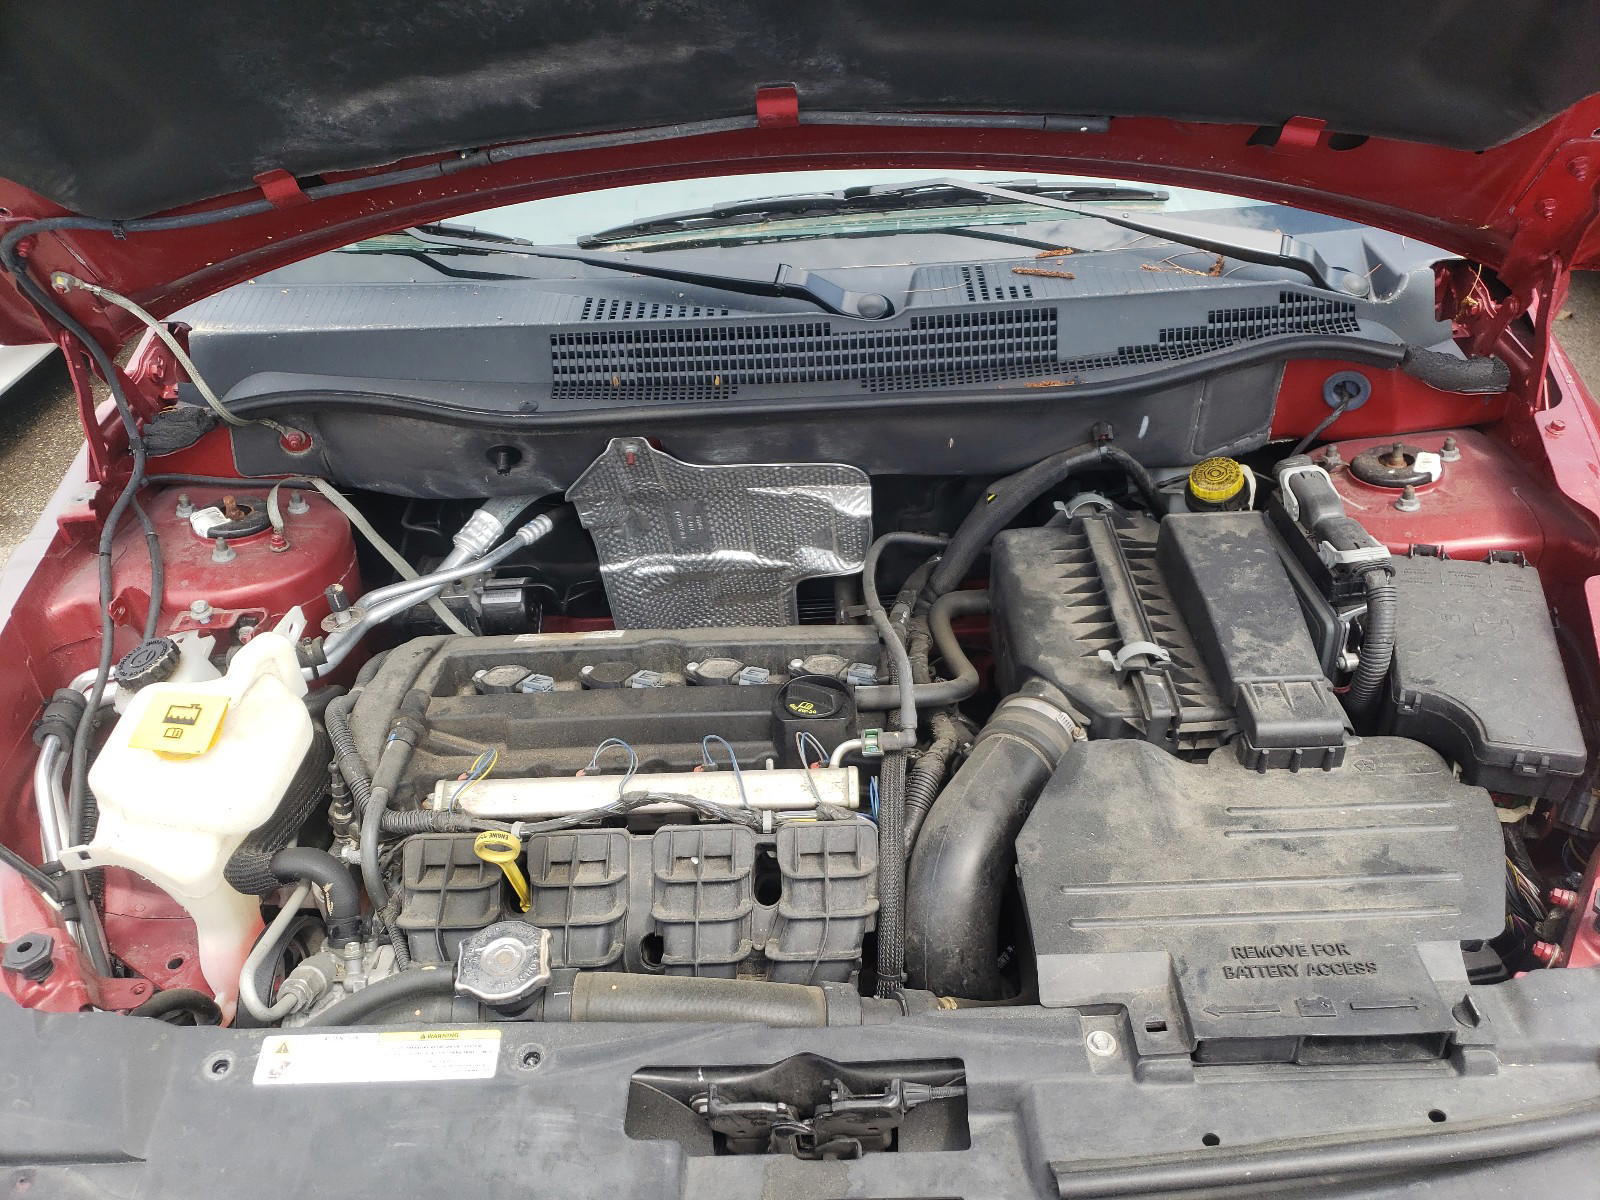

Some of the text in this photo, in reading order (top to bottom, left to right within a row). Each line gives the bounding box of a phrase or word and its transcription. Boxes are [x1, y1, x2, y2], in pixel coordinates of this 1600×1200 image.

[1231, 942, 1352, 959] REMOVE FOR
[1223, 961, 1378, 979] BATTERY ACCESS
